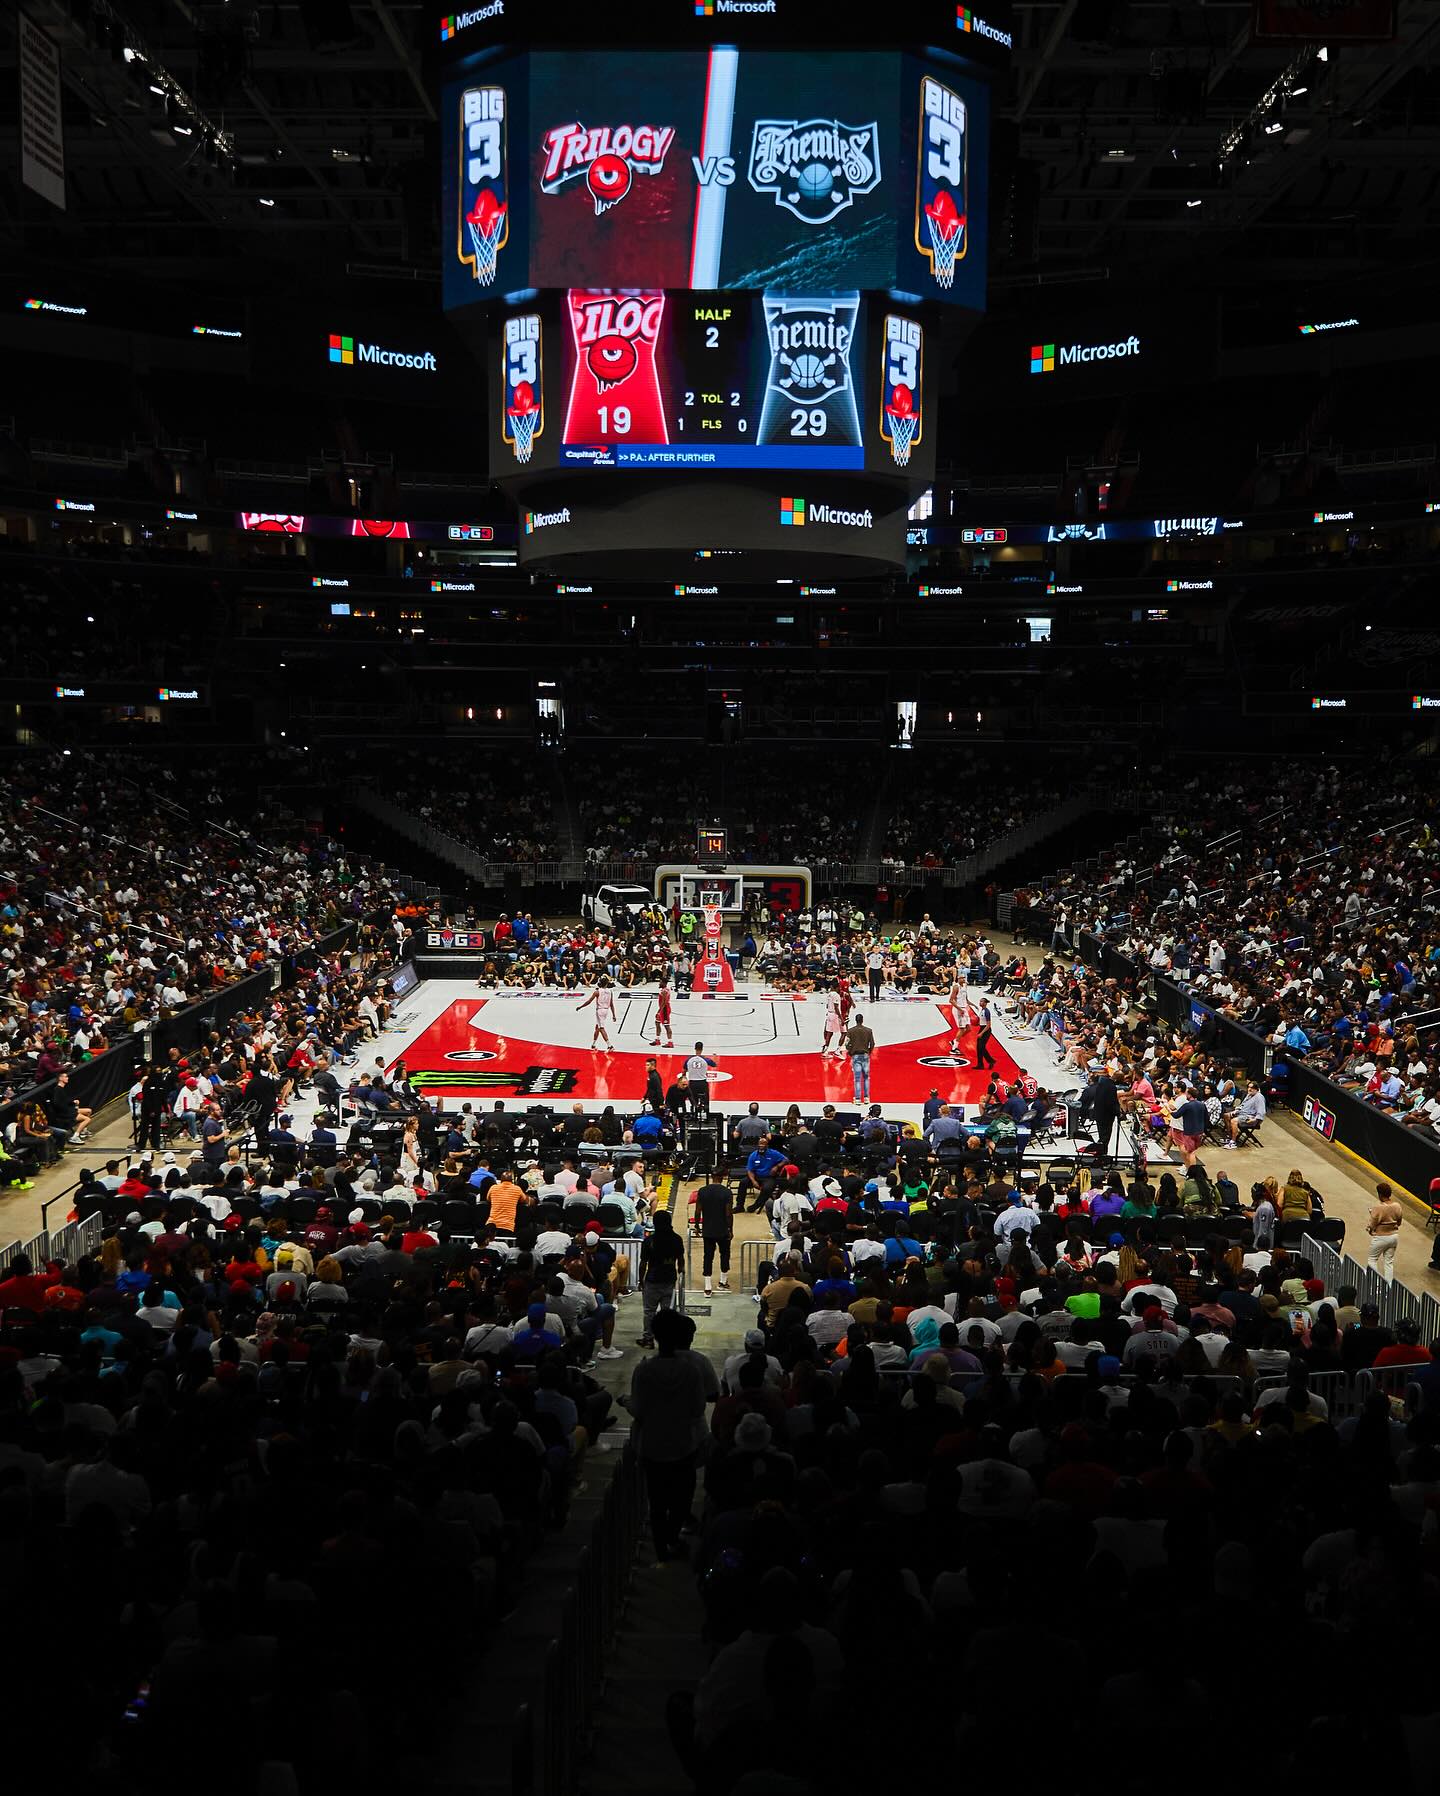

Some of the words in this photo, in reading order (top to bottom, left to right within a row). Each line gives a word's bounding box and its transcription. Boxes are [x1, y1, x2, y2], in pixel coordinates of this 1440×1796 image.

[717, 0, 777, 13] Microsoft
[457, 0, 505, 31] Microsoft
[973, 16, 1012, 49] Microsof
[463, 89, 504, 123] BIG
[923, 79, 966, 135] BIG
[469, 119, 501, 185] 3
[545, 123, 673, 179] TRILOGY
[928, 116, 962, 186] 3
[692, 156, 736, 186] VS
[43, 302, 87, 316] Microsoft
[694, 308, 732, 321] HALF
[505, 317, 540, 344] BIG
[887, 317, 921, 345] BIG
[1314, 318, 1360, 332] Microsoft
[705, 327, 719, 348] 2
[358, 343, 437, 371] Microsoft
[1059, 335, 1140, 365] Microsoft
[509, 340, 536, 388] 3
[889, 341, 918, 390] 3
[684, 392, 695, 406] 2
[701, 394, 724, 404] TOL
[730, 392, 741, 406] 2
[597, 406, 632, 434] 19
[677, 418, 684, 431] 1
[701, 419, 722, 430] FLS
[737, 418, 748, 433] 0
[790, 408, 827, 437] 29
[648, 453, 676, 462] AFTER
[677, 453, 716, 462] FURTHER
[66, 501, 95, 511] Microsoft
[174, 512, 198, 520] Microsoft
[533, 507, 571, 528] Microsoft
[809, 503, 873, 529] Microsoft
[1324, 511, 1354, 521] Microsoft
[321, 579, 349, 587] Microsoft
[442, 582, 476, 591] Microsoft
[686, 586, 719, 594] Microsoft
[1056, 585, 1083, 593] Microsoft
[1178, 580, 1214, 590] Microsoft
[809, 587, 836, 595] Microsoft
[929, 586, 963, 595] Microsoft
[169, 690, 199, 699] Microsoft
[1320, 699, 1347, 707] Microsoft
[709, 839, 721, 851] 14
[1026, 1082, 1035, 1096] 3
